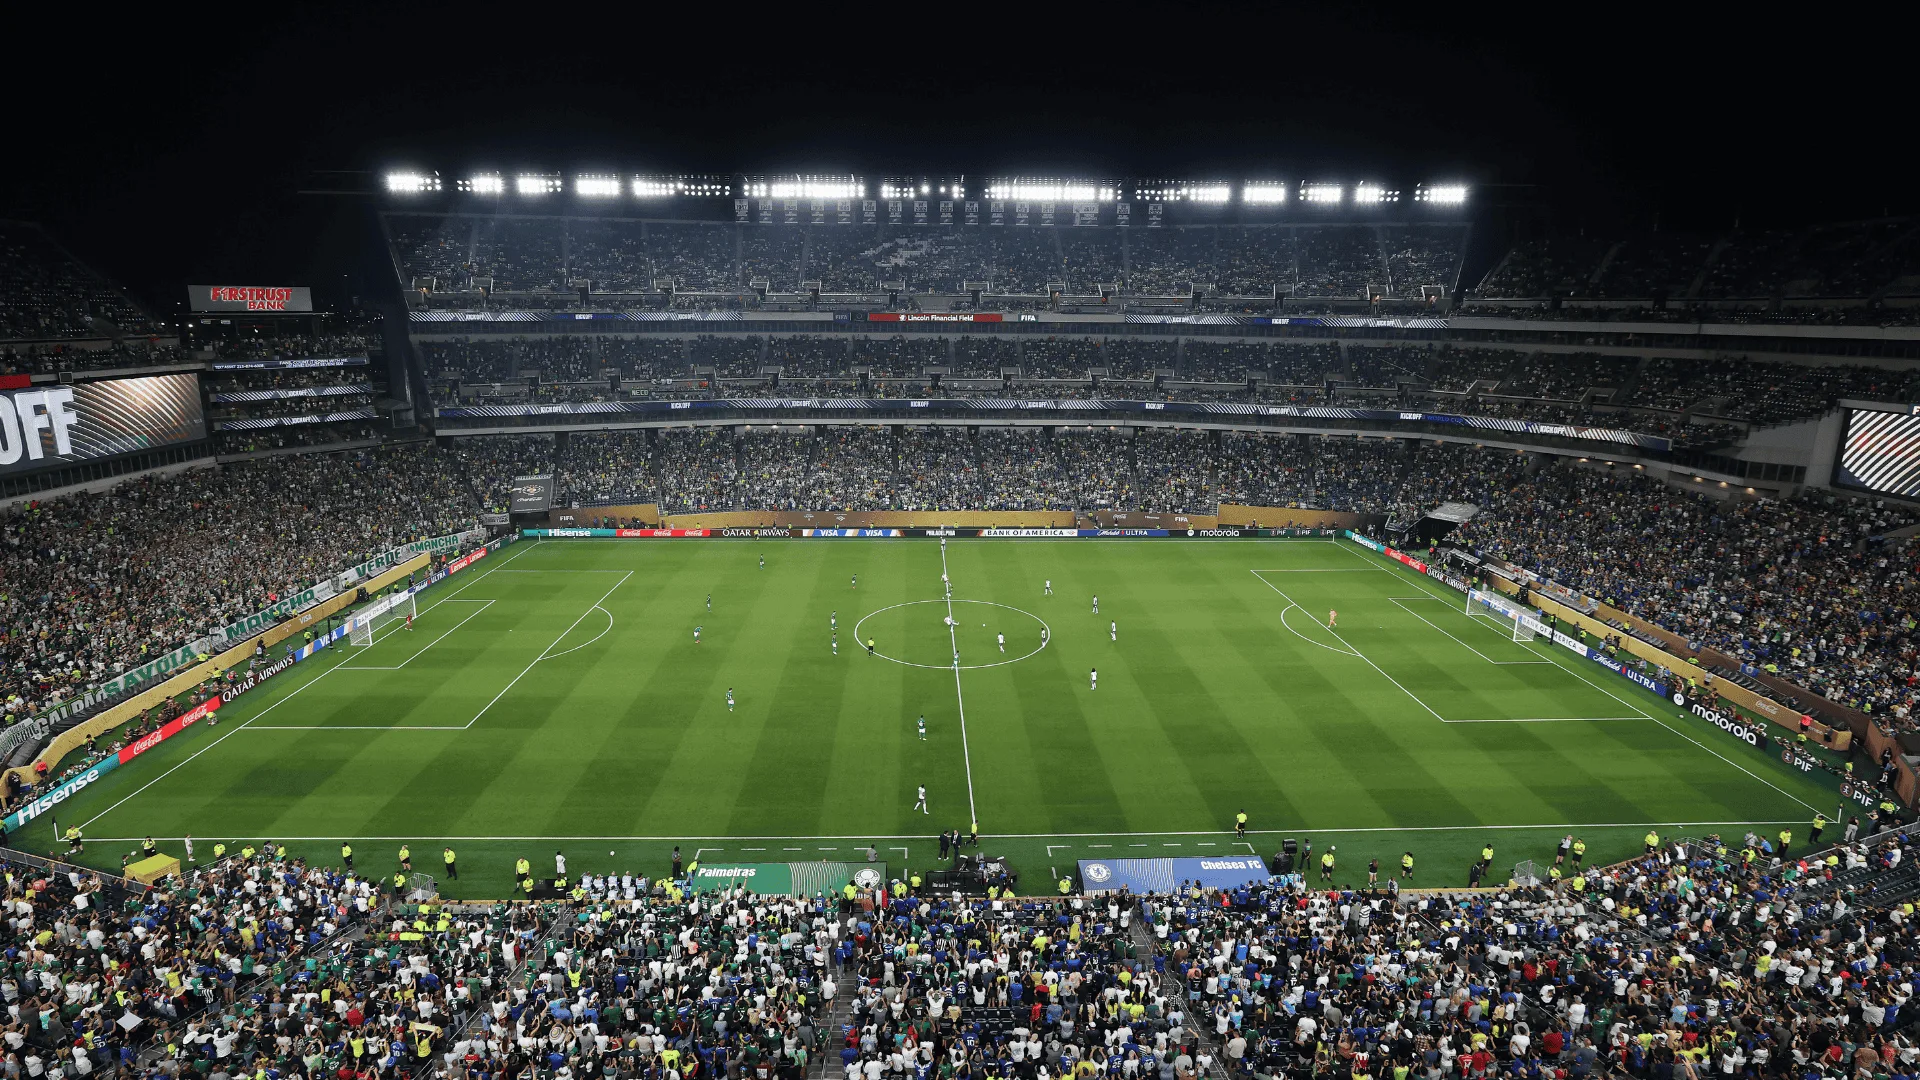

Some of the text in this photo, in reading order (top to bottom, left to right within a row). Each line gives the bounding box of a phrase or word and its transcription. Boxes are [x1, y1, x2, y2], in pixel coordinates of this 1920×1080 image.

[247, 301, 285, 311] BANK
[548, 528, 591, 537] Hisense
[622, 529, 641, 537] Coca-Cola
[653, 529, 672, 537] Coca-Cola
[684, 529, 703, 537] Coca-Cola
[722, 529, 751, 537] QATAR
[820, 529, 839, 537] VISA
[864, 529, 883, 537] VISA
[1200, 529, 1240, 537] motorola
[415, 535, 459, 552] MANCHA
[1351, 532, 1378, 551] Hisense
[431, 570, 447, 583] ULTRA
[1426, 566, 1469, 593] QATAR AIRWAYS
[299, 613, 313, 624] VISA
[1522, 615, 1539, 630] BANK
[1539, 626, 1550, 636] OF
[222, 654, 294, 703] QATAR AIRWAYS
[1627, 670, 1656, 691] ULTRA
[182, 703, 208, 727] Coca-Cola
[1691, 703, 1757, 746] motorola
[133, 729, 162, 755] Coca-Cola
[1793, 756, 1813, 773] PIF
[16, 768, 99, 827] Hisense
[1853, 789, 1874, 807] PIF
[1200, 860, 1262, 870] Chelsea FC
[697, 867, 756, 877] Palmeiras
[1246, 1063, 1253, 1071] 10
